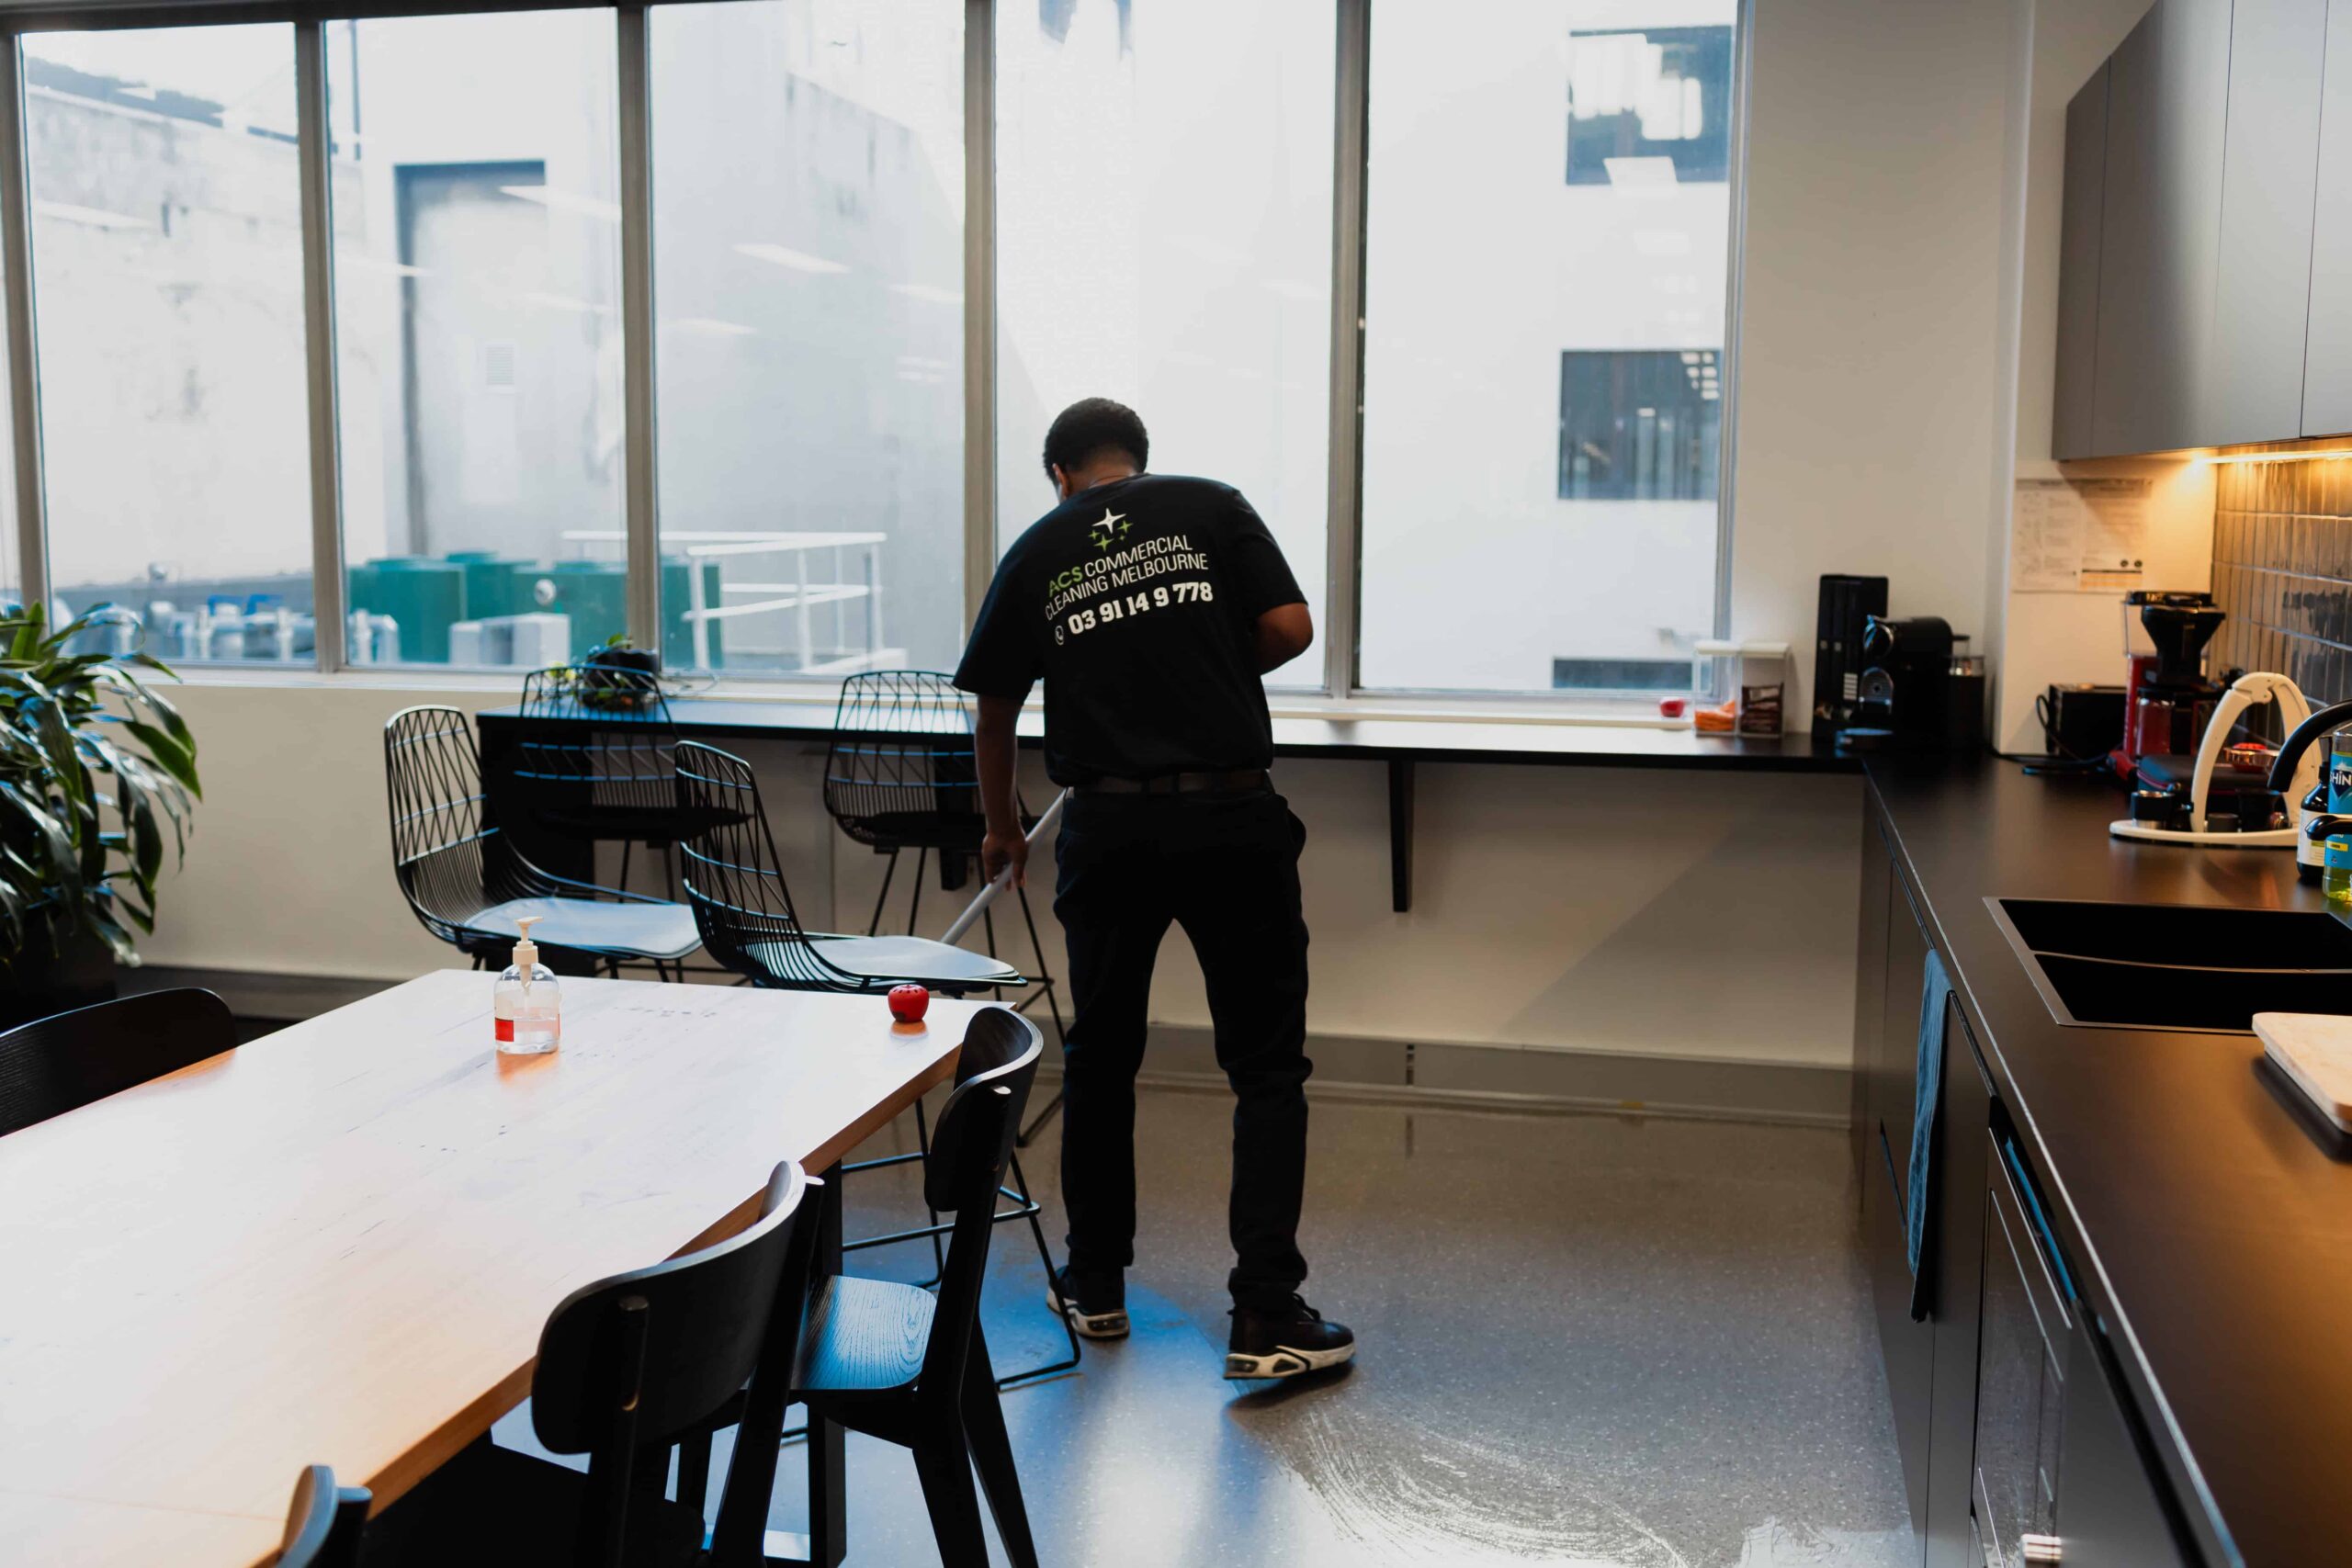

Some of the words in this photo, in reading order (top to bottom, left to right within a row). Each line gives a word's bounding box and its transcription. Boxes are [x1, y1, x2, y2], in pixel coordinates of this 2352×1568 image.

[1045, 576, 1109, 620] CLEANING
[1112, 553, 1209, 588] MELBOURNE
[1048, 567, 1083, 597] ACS
[1084, 535, 1193, 577] COMMERCIAL
[1068, 609, 1096, 635] 03
[1099, 600, 1124, 623] 91
[1126, 592, 1150, 615] 14
[1153, 587, 1170, 607] 9
[1172, 581, 1214, 604] 778
